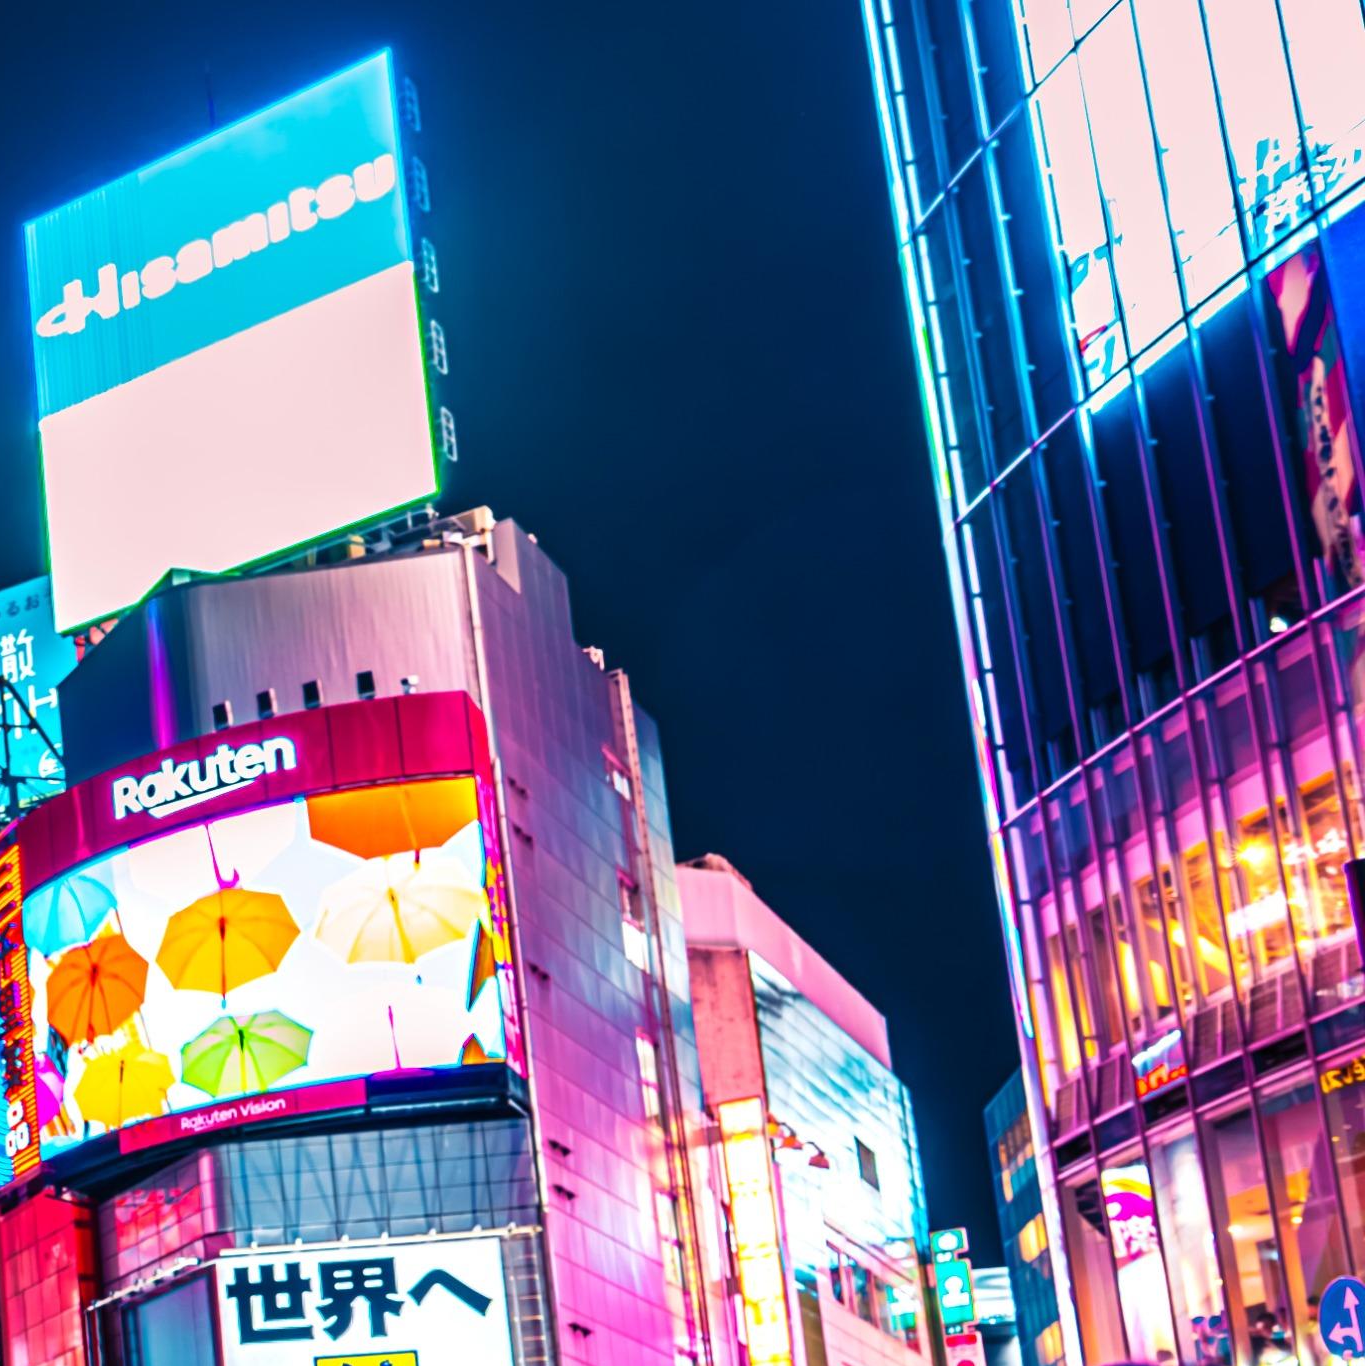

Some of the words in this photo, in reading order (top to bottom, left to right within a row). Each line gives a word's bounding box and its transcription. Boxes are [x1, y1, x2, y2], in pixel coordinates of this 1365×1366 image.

[35, 153, 397, 338] Hisamitsu
[112, 735, 297, 820] Rakuten
[180, 1107, 238, 1131] Rakuten
[239, 1097, 286, 1118] Vision
[225, 1255, 494, 1347] 世界へ
